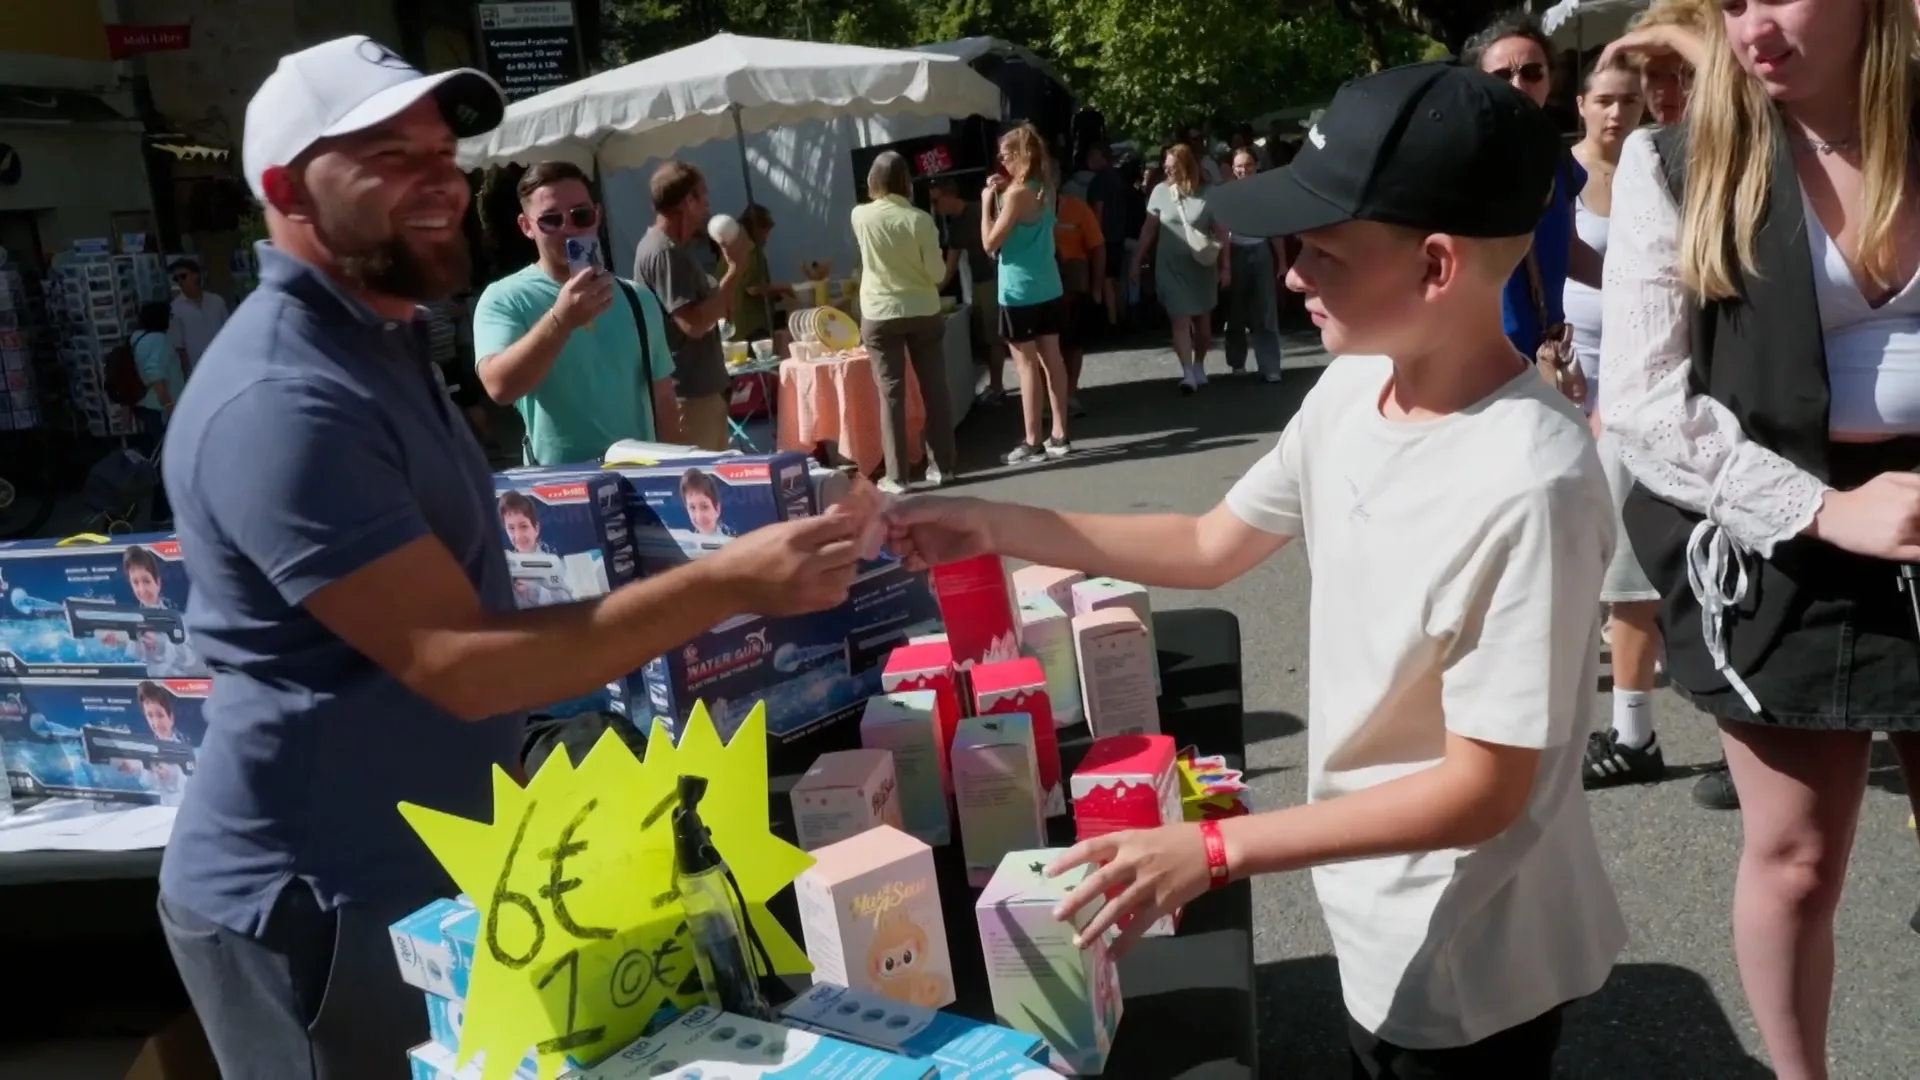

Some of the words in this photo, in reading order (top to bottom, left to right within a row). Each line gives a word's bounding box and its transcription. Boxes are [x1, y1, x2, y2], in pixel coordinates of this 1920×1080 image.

[152, 33, 182, 44] Libre
[687, 653, 731, 676] WATER
[734, 640, 762, 660] GUN
[486, 798, 618, 969] 6€
